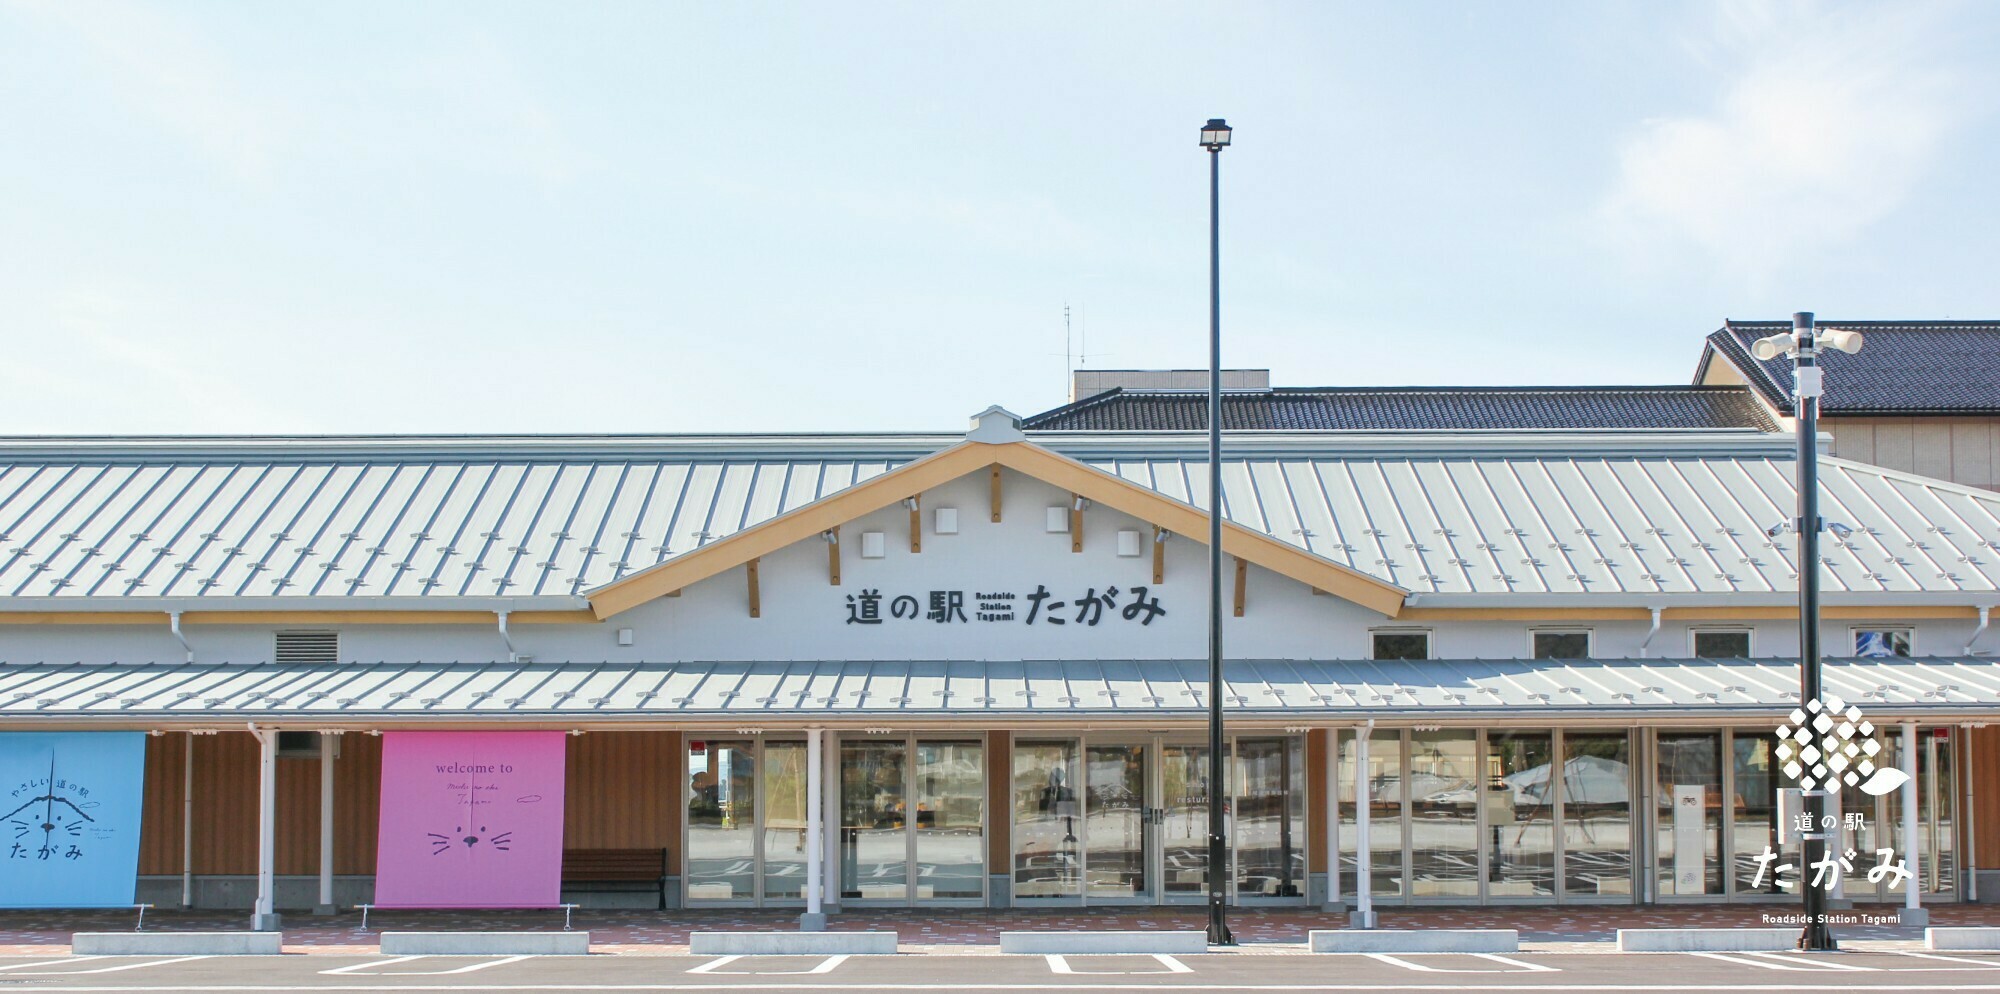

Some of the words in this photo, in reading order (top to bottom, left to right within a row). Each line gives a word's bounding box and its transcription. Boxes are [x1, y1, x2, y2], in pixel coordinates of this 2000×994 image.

[975, 592, 1016, 601] Roadside
[845, 588, 968, 625] 道の駅
[1026, 584, 1166, 626] たがみ
[979, 602, 1012, 611] Station
[976, 612, 1015, 622] Tagami
[436, 762, 495, 774] welcome
[500, 763, 513, 774] to
[11, 778, 49, 798] やさしい
[56, 779, 90, 799] 道の駅
[10, 842, 83, 861] たがみ
